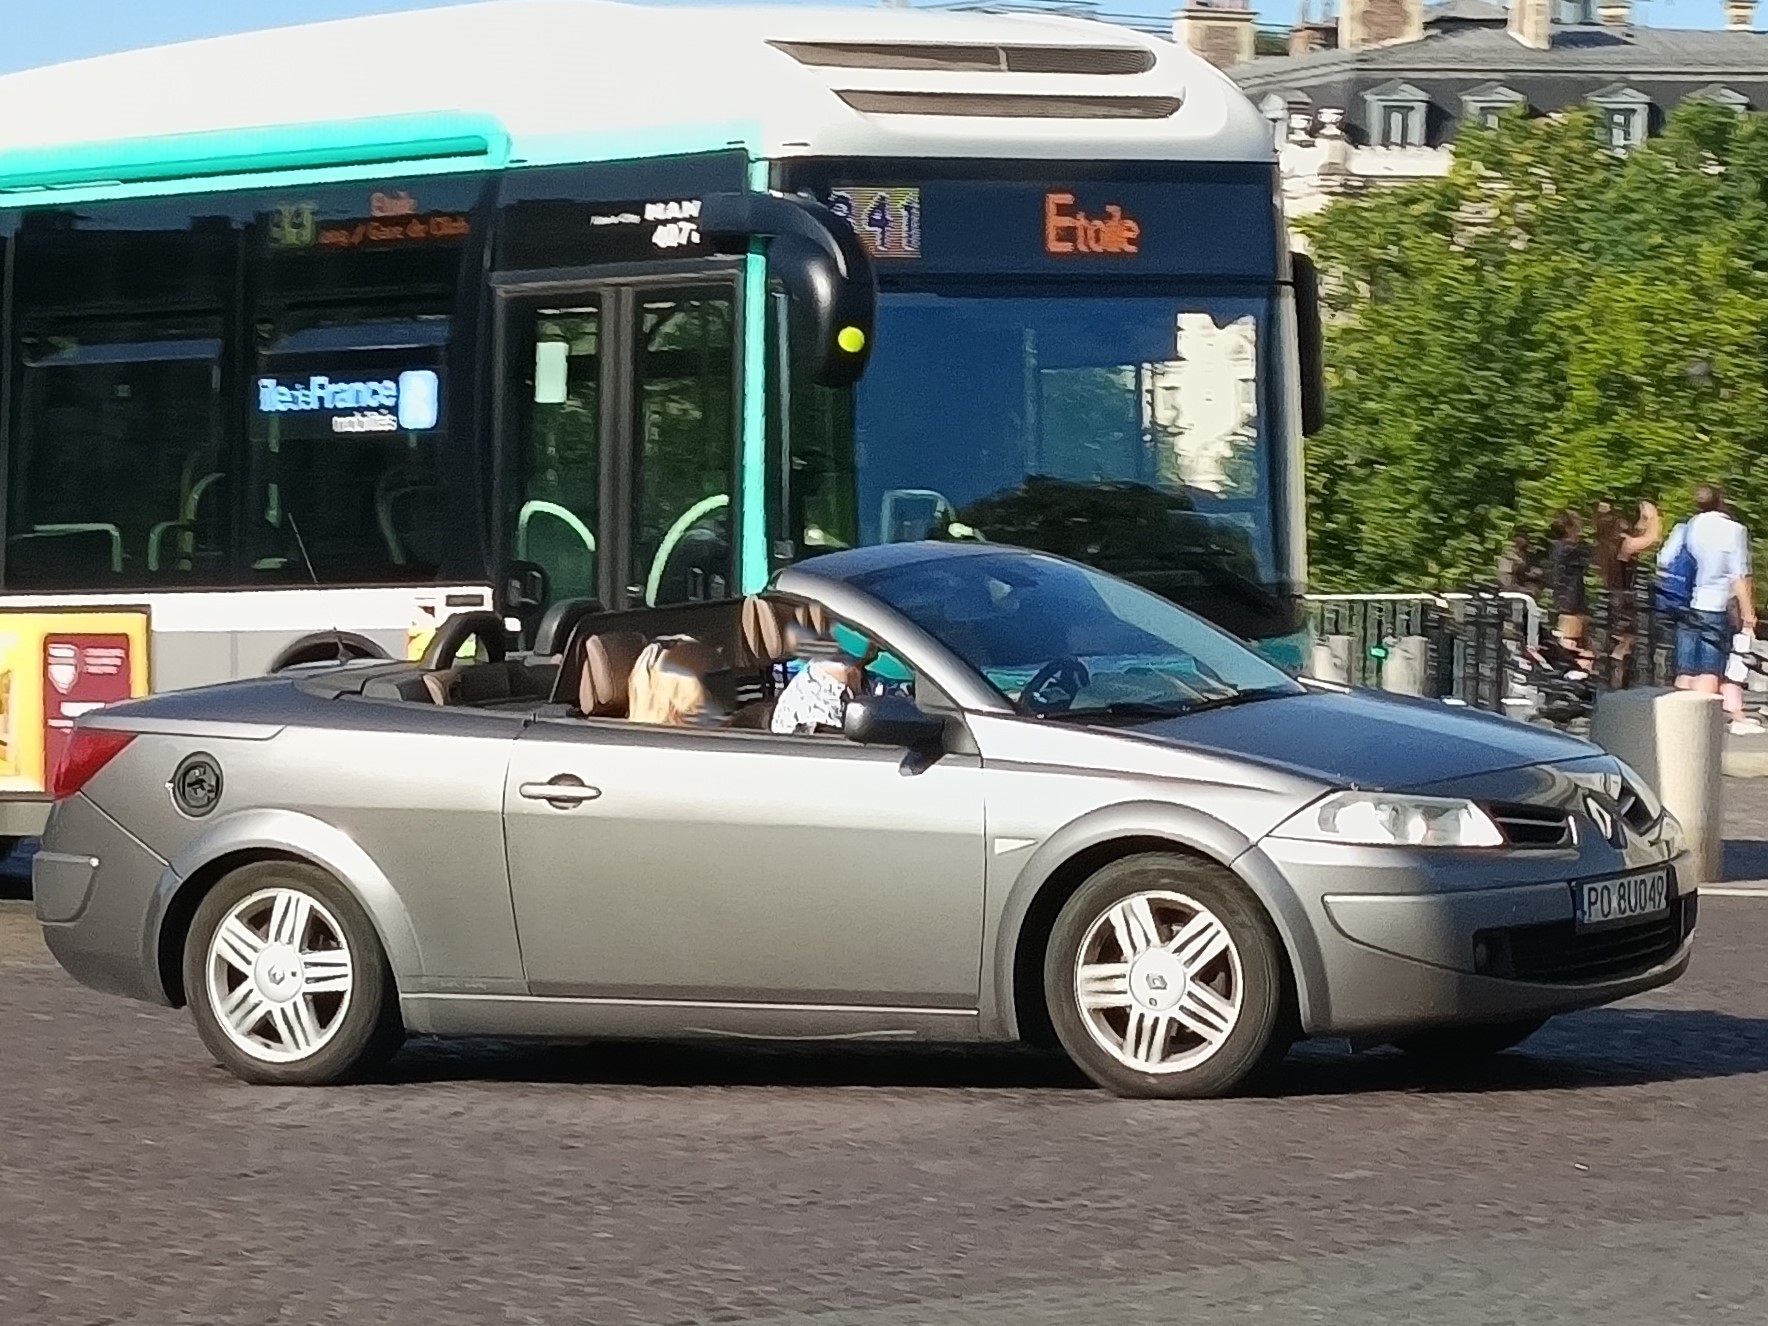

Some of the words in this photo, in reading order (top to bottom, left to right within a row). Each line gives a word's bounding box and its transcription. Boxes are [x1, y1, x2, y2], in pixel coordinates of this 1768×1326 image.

[1045, 193, 1140, 252] Etoile
[1587, 884, 1612, 919] PO
[1617, 875, 1665, 915] 8U049
